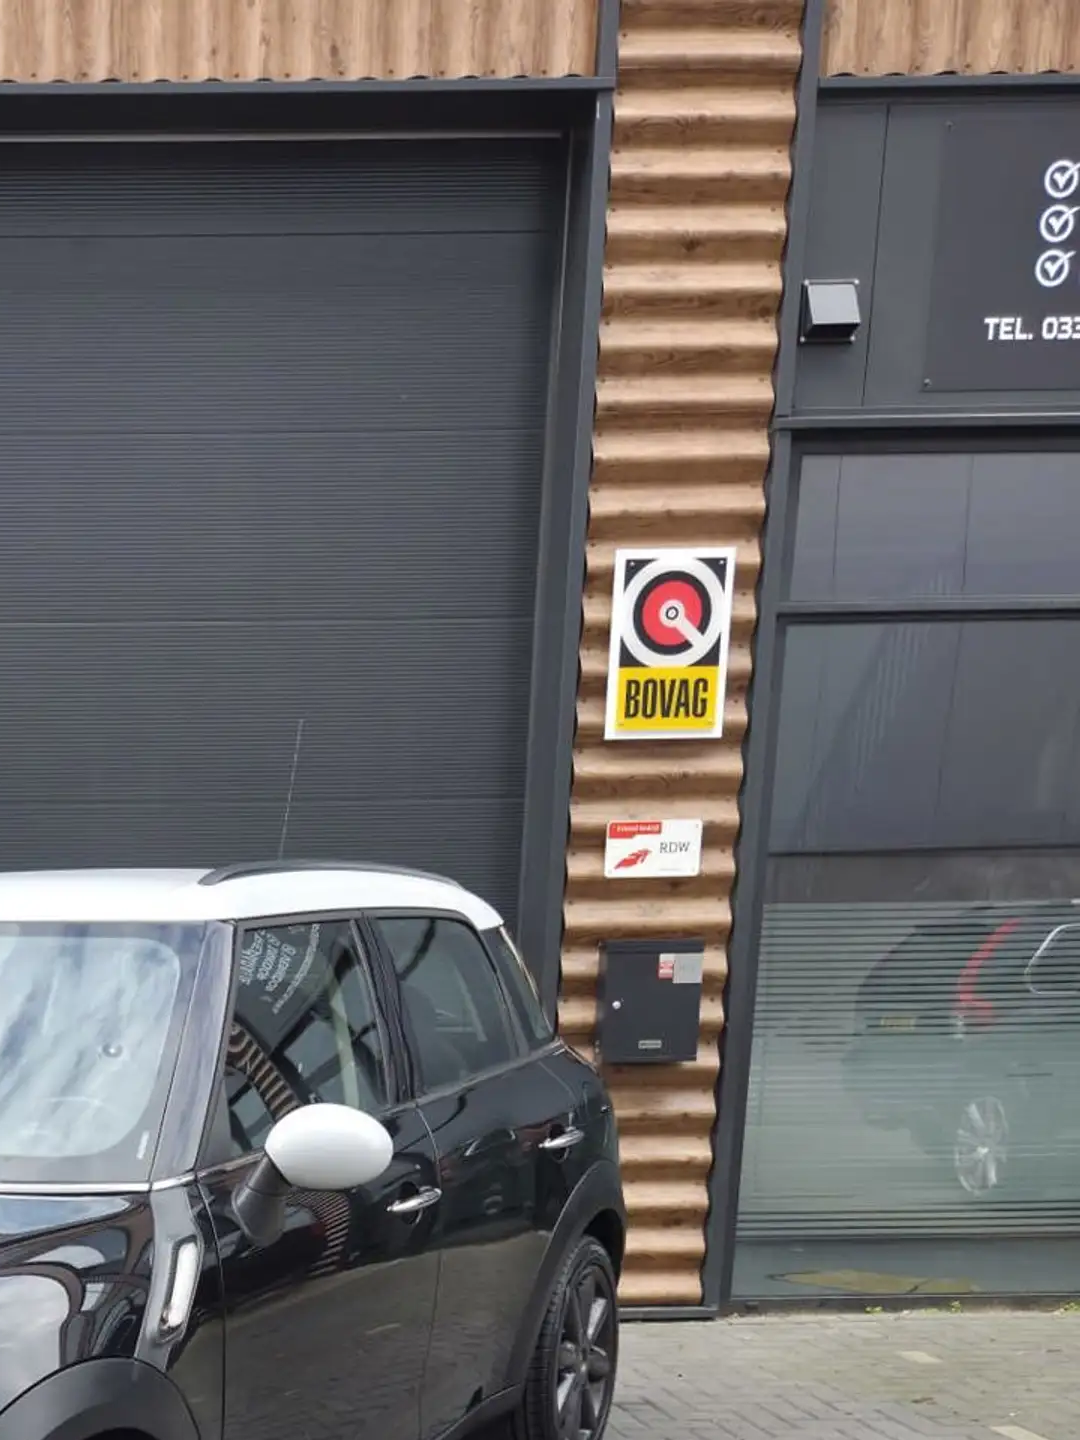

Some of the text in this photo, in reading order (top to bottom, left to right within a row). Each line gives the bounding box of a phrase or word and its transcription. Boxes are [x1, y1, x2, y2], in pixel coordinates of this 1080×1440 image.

[983, 316, 1033, 341] TEL.
[624, 678, 708, 719] BOVAG
[659, 841, 690, 853] RDW
